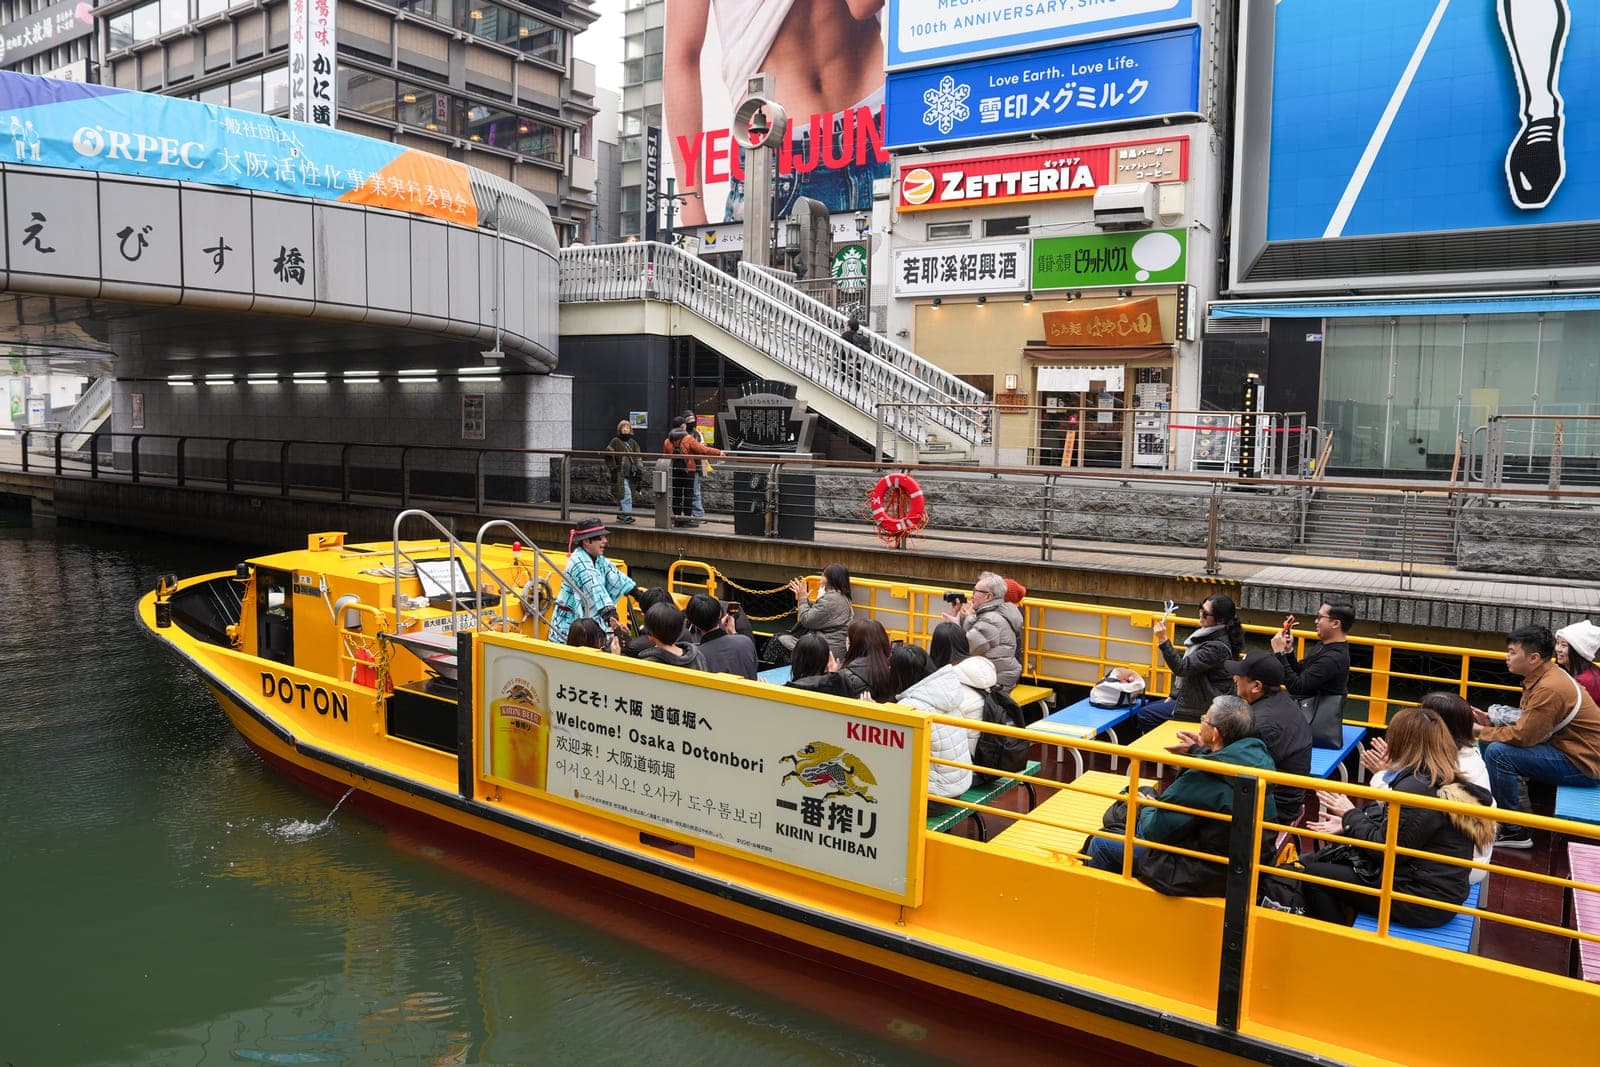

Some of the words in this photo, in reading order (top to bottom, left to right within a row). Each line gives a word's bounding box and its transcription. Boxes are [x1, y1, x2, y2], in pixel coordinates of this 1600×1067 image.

[910, 20, 947, 37] 100th
[954, 0, 1074, 30] ANNIVERSARY,
[989, 75, 1019, 88] Love
[1023, 66, 1065, 83] Earth.
[1071, 61, 1103, 76] Love
[1107, 56, 1139, 71] Life.
[979, 78, 1149, 124] 雪印メグミルク
[646, 135, 658, 213] TSUTAYA
[1043, 157, 1080, 168] ゼッテリア
[1136, 169, 1172, 179] コーヒー
[216, 147, 469, 217] 大阪活性化事業実行委員会
[940, 165, 1095, 200] ZETTERIA
[1074, 246, 1128, 274] ピタットハウス
[261, 672, 348, 722] DOTON
[556, 684, 608, 708] ようこそ!
[614, 697, 643, 717] 大阪
[651, 704, 713, 731] 道頓堀へ
[522, 710, 540, 724] BEER
[847, 721, 905, 750] KIRIN
[556, 711, 621, 739] Welcome!
[629, 728, 675, 752] Osaka
[682, 740, 764, 773] Dotonbori
[607, 748, 676, 780] 大阪道顿堀
[556, 759, 636, 793] 어서오십시오!
[640, 782, 683, 807] 오사카
[687, 795, 762, 829] 도우톰보리
[776, 796, 877, 839] 一番搾り
[776, 822, 814, 843] KIRIN
[819, 833, 877, 860] ICHIBAN
